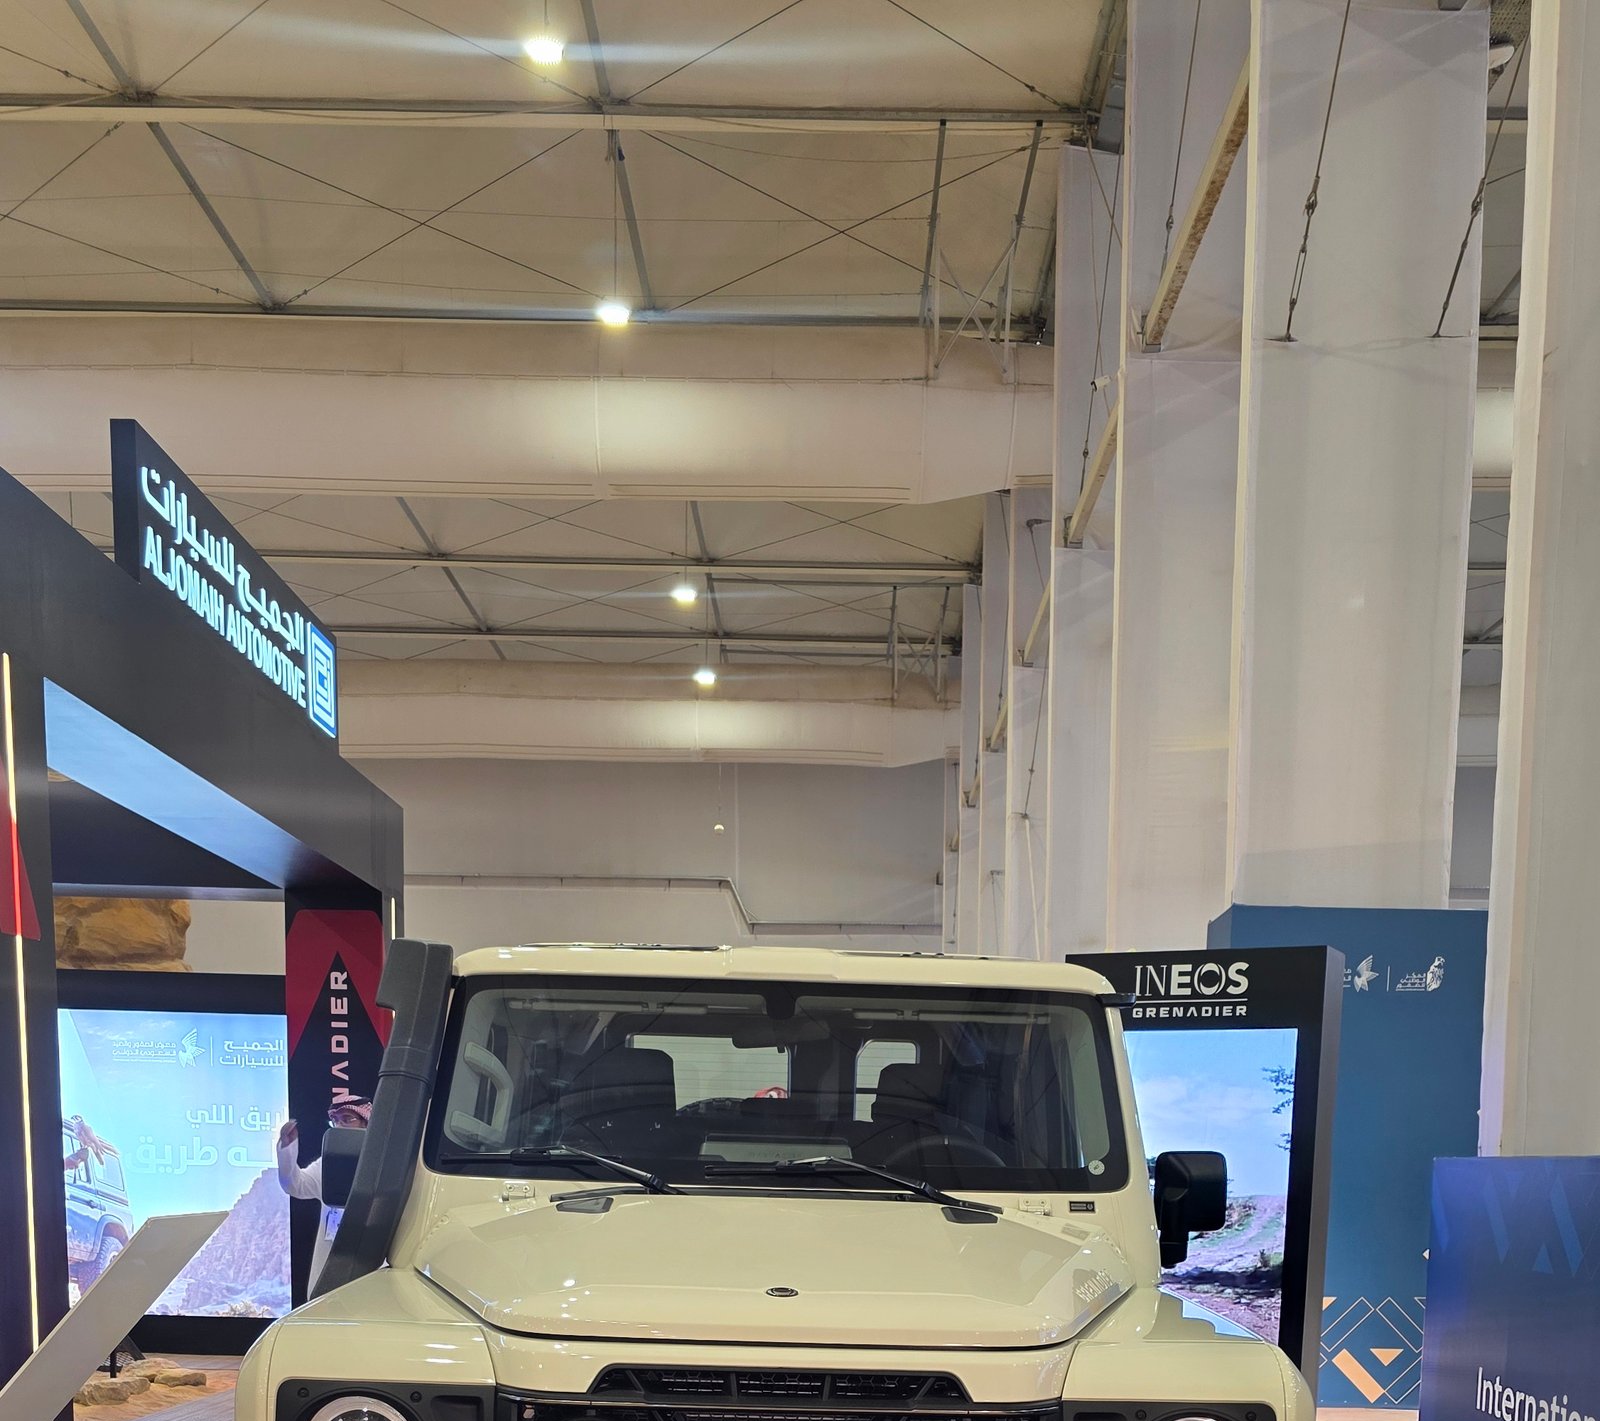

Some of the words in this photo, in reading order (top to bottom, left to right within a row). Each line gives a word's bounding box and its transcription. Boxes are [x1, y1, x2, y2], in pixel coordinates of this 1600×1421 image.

[141, 466, 235, 586] للسيارات
[144, 525, 225, 637] ALJOMAIH
[226, 603, 306, 709] AUTOMOTIVE
[237, 564, 305, 655] الجميح
[1134, 962, 1250, 996] INEOS
[1132, 1005, 1247, 1018] GRENADIER
[219, 1054, 283, 1069] للسيارات
[223, 1039, 283, 1053] الجميح
[186, 1104, 234, 1129] اللي
[124, 1136, 218, 1175] طريق
